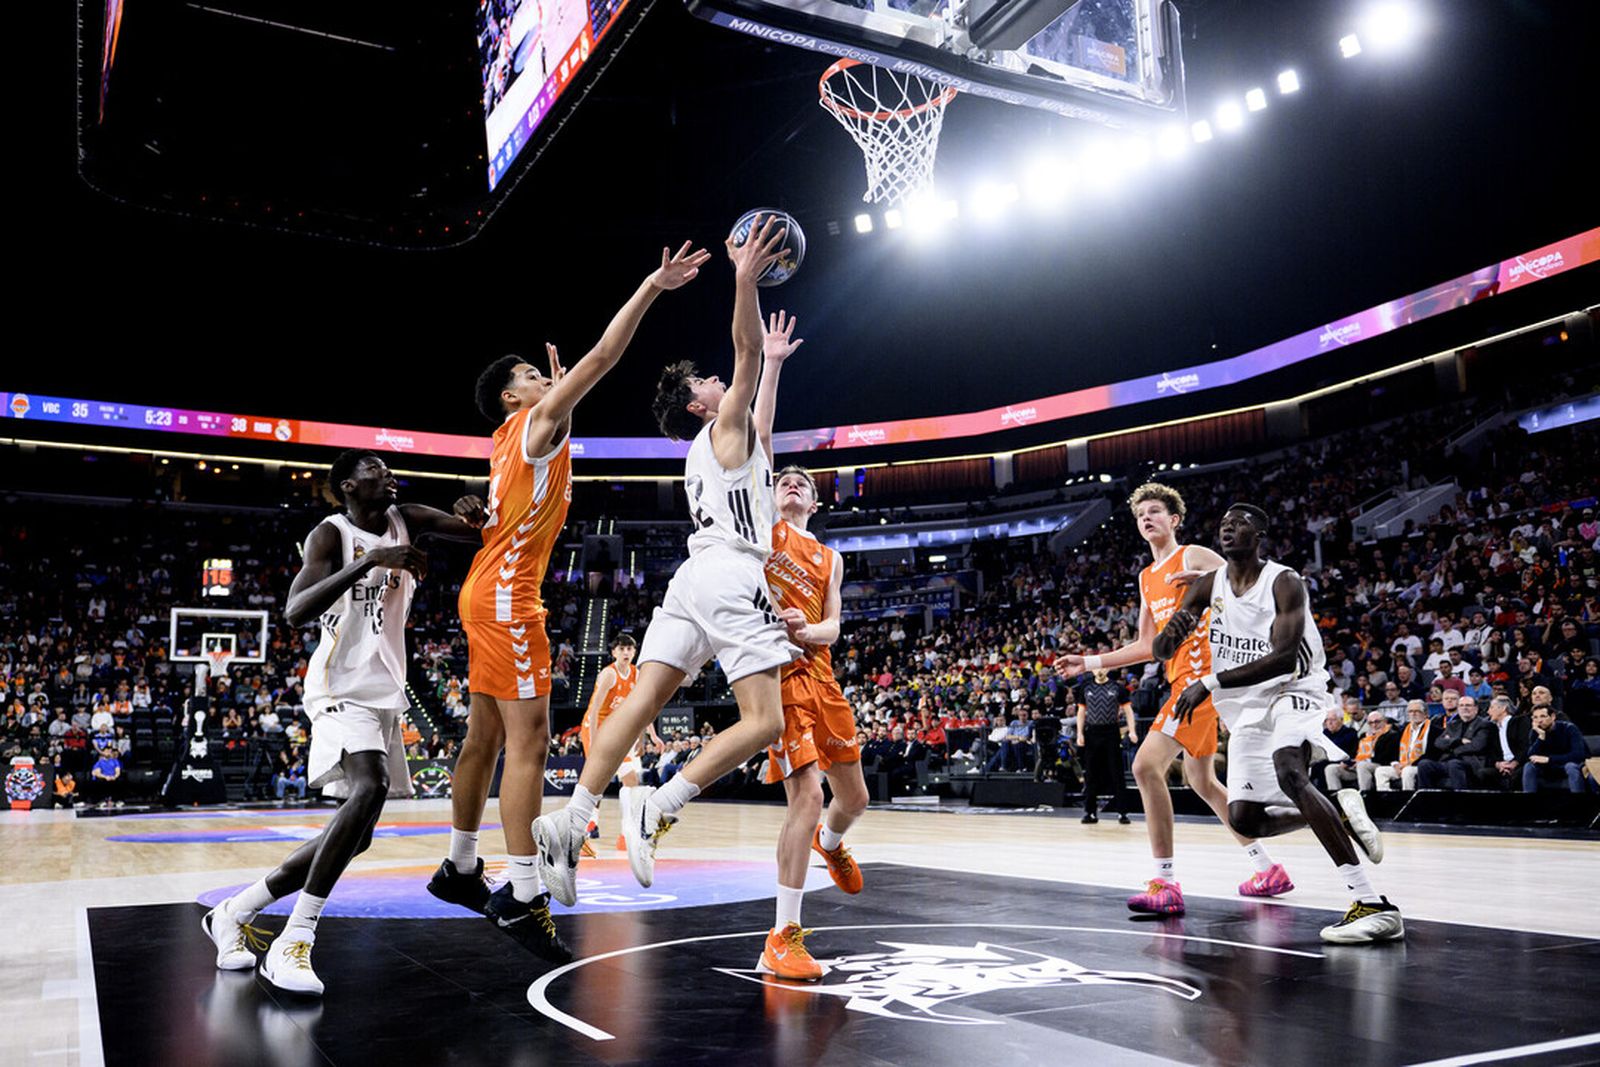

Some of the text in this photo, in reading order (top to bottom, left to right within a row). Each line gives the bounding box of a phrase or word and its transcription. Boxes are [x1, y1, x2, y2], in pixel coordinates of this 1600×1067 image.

[729, 18, 816, 49] MINICOPA
[819, 43, 880, 64] endesa
[893, 60, 972, 93] MINICOPA
[42, 401, 60, 414] VBC
[72, 402, 88, 418] 35
[145, 409, 172, 426] 5:23
